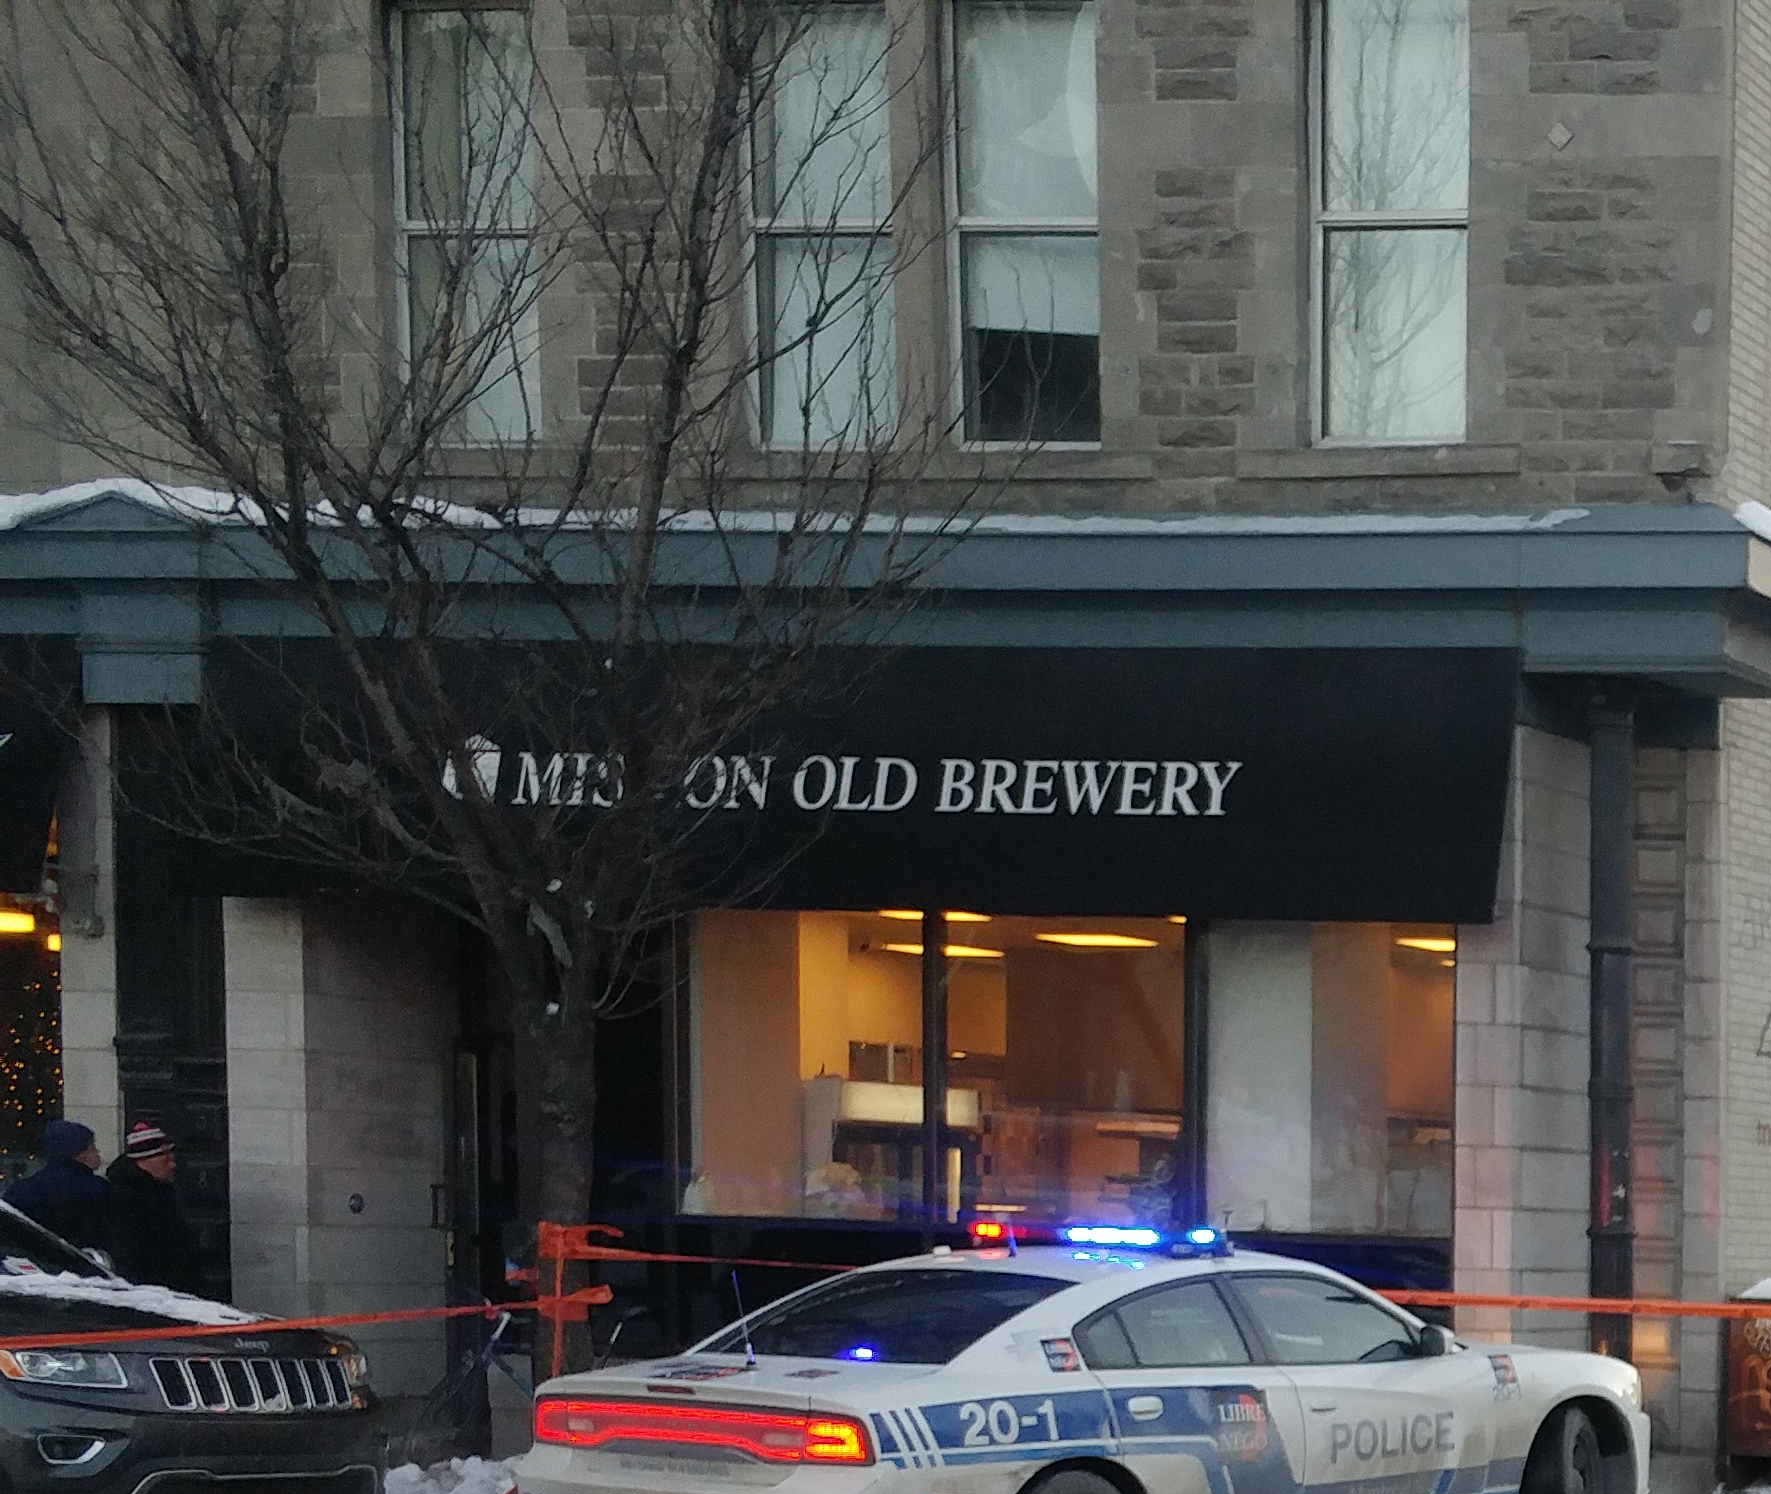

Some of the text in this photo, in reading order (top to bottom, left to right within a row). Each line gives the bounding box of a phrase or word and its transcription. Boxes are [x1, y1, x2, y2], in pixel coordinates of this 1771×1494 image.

[511, 750, 1243, 817] MISON OLD BREWERY
[235, 1337, 270, 1353] Jeep
[959, 1398, 1059, 1447] 20-1
[1217, 1403, 1266, 1423] LIBRE
[1330, 1411, 1456, 1465] POLICE
